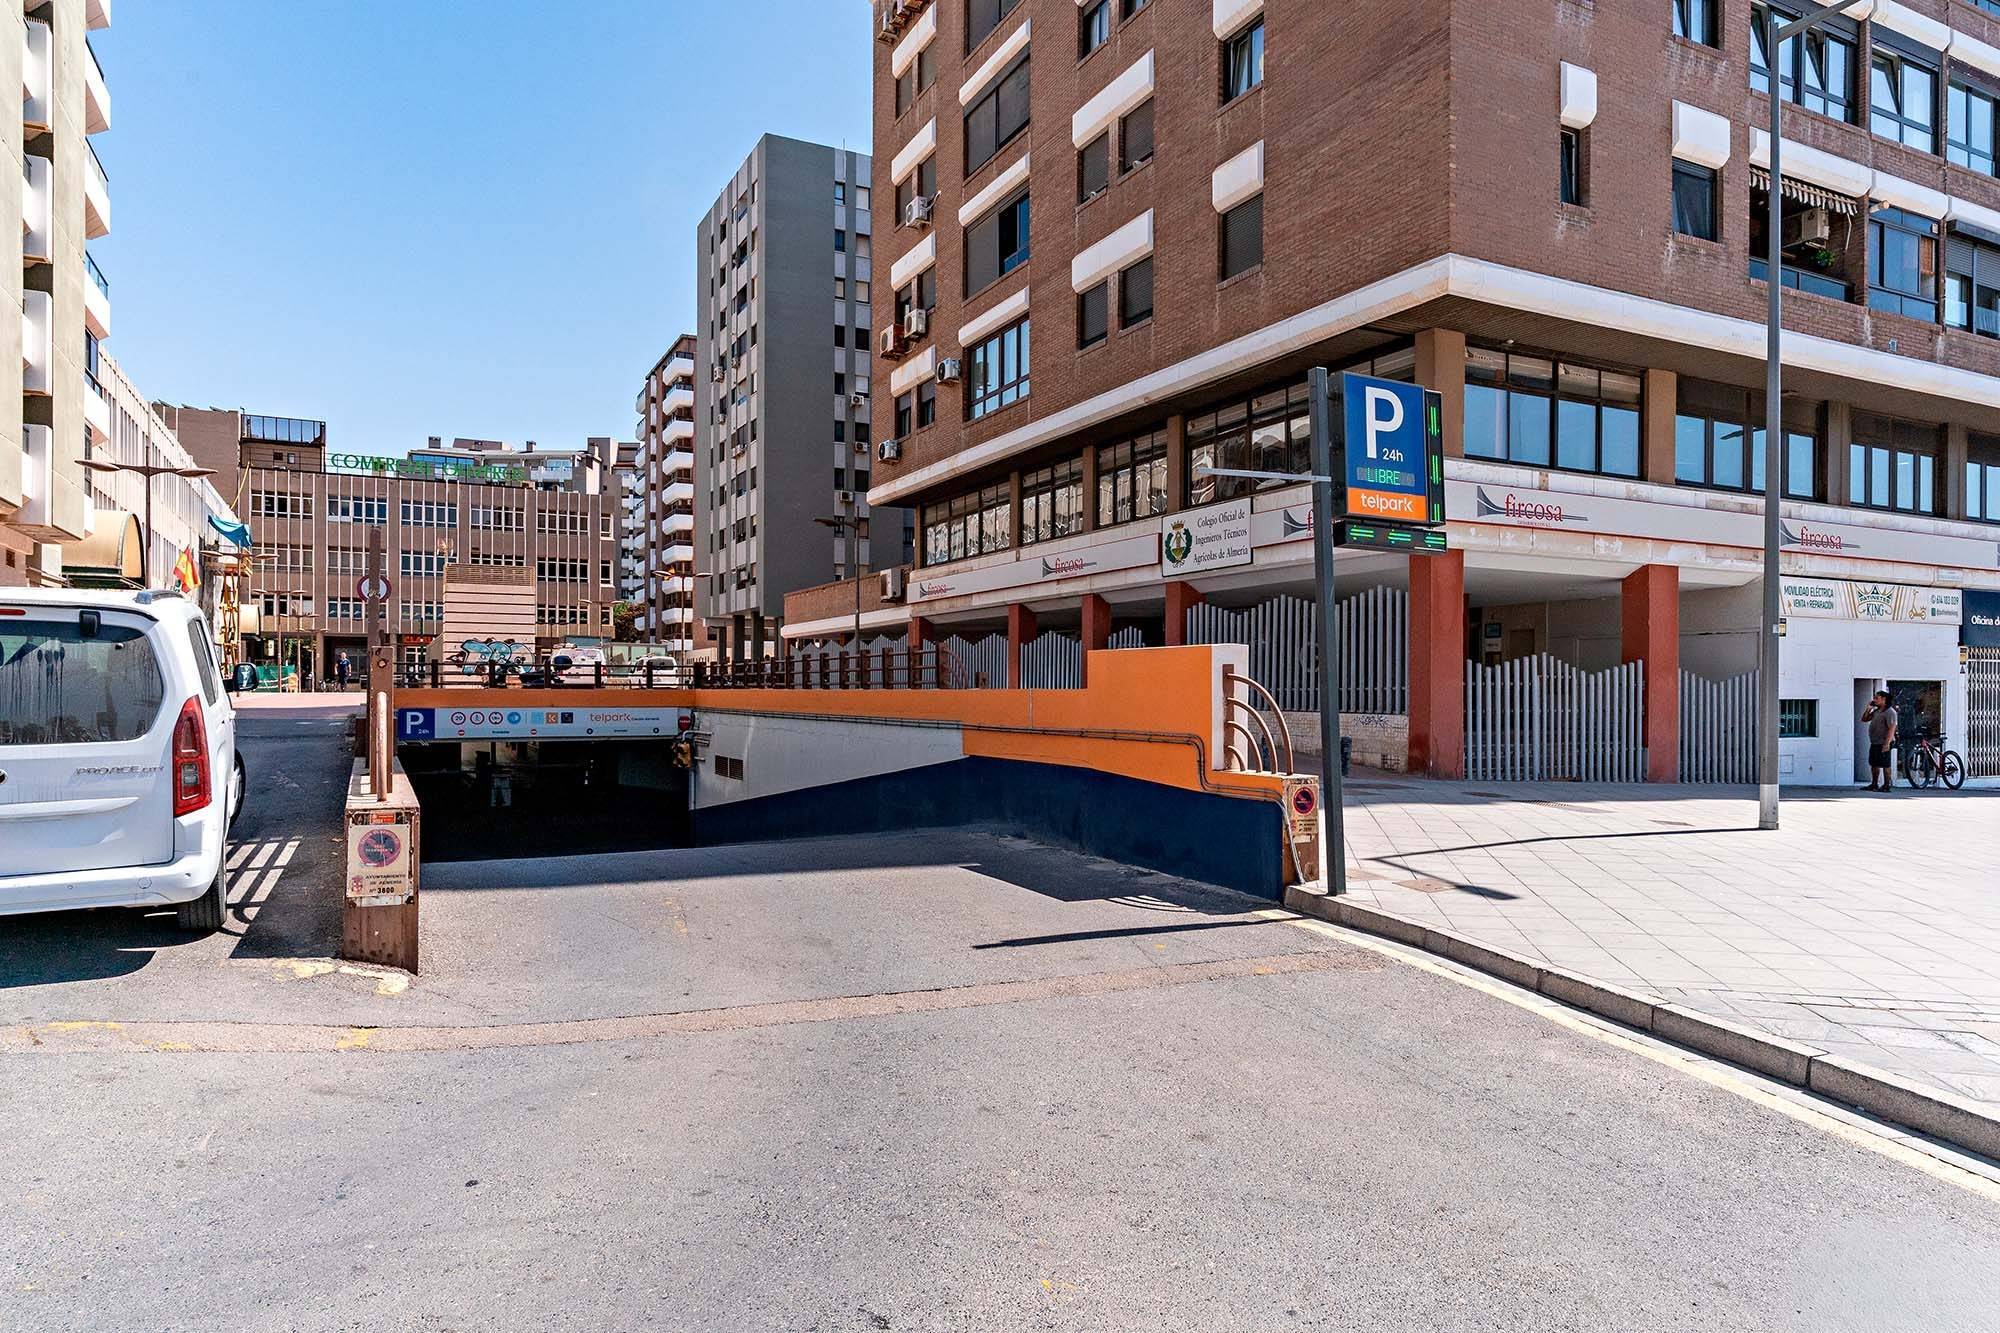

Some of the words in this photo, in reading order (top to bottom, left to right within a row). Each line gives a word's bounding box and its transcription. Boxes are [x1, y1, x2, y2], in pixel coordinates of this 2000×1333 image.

[1365, 386, 1404, 459] P
[1382, 448, 1404, 462] 24h
[331, 453, 430, 476] COMERCIAL
[1367, 467, 1401, 485] LIBRE
[1361, 493, 1413, 513] telpark
[1505, 493, 1563, 521] fircosa
[1197, 515, 1217, 529] Colegio
[1218, 512, 1237, 524] Oficial
[1238, 508, 1245, 519] de
[1195, 532, 1222, 546] Ingenieros
[1223, 528, 1248, 540] Técnicos
[1800, 526, 1842, 550] fircosa
[1193, 551, 1217, 566] Agrícolas
[1218, 550, 1226, 559] de
[1226, 545, 1248, 558] Almería
[1055, 557, 1084, 574] fircosa
[1784, 585, 1809, 597] MOVILIDAD
[1810, 585, 1833, 598] ELÉCTRICA
[1793, 599, 1806, 609] VENTA
[1866, 603, 1884, 616] KING
[1971, 615, 1994, 626] Oficina
[406, 711, 424, 734] P
[590, 712, 631, 723] telpark
[75, 765, 141, 775] PROACE
